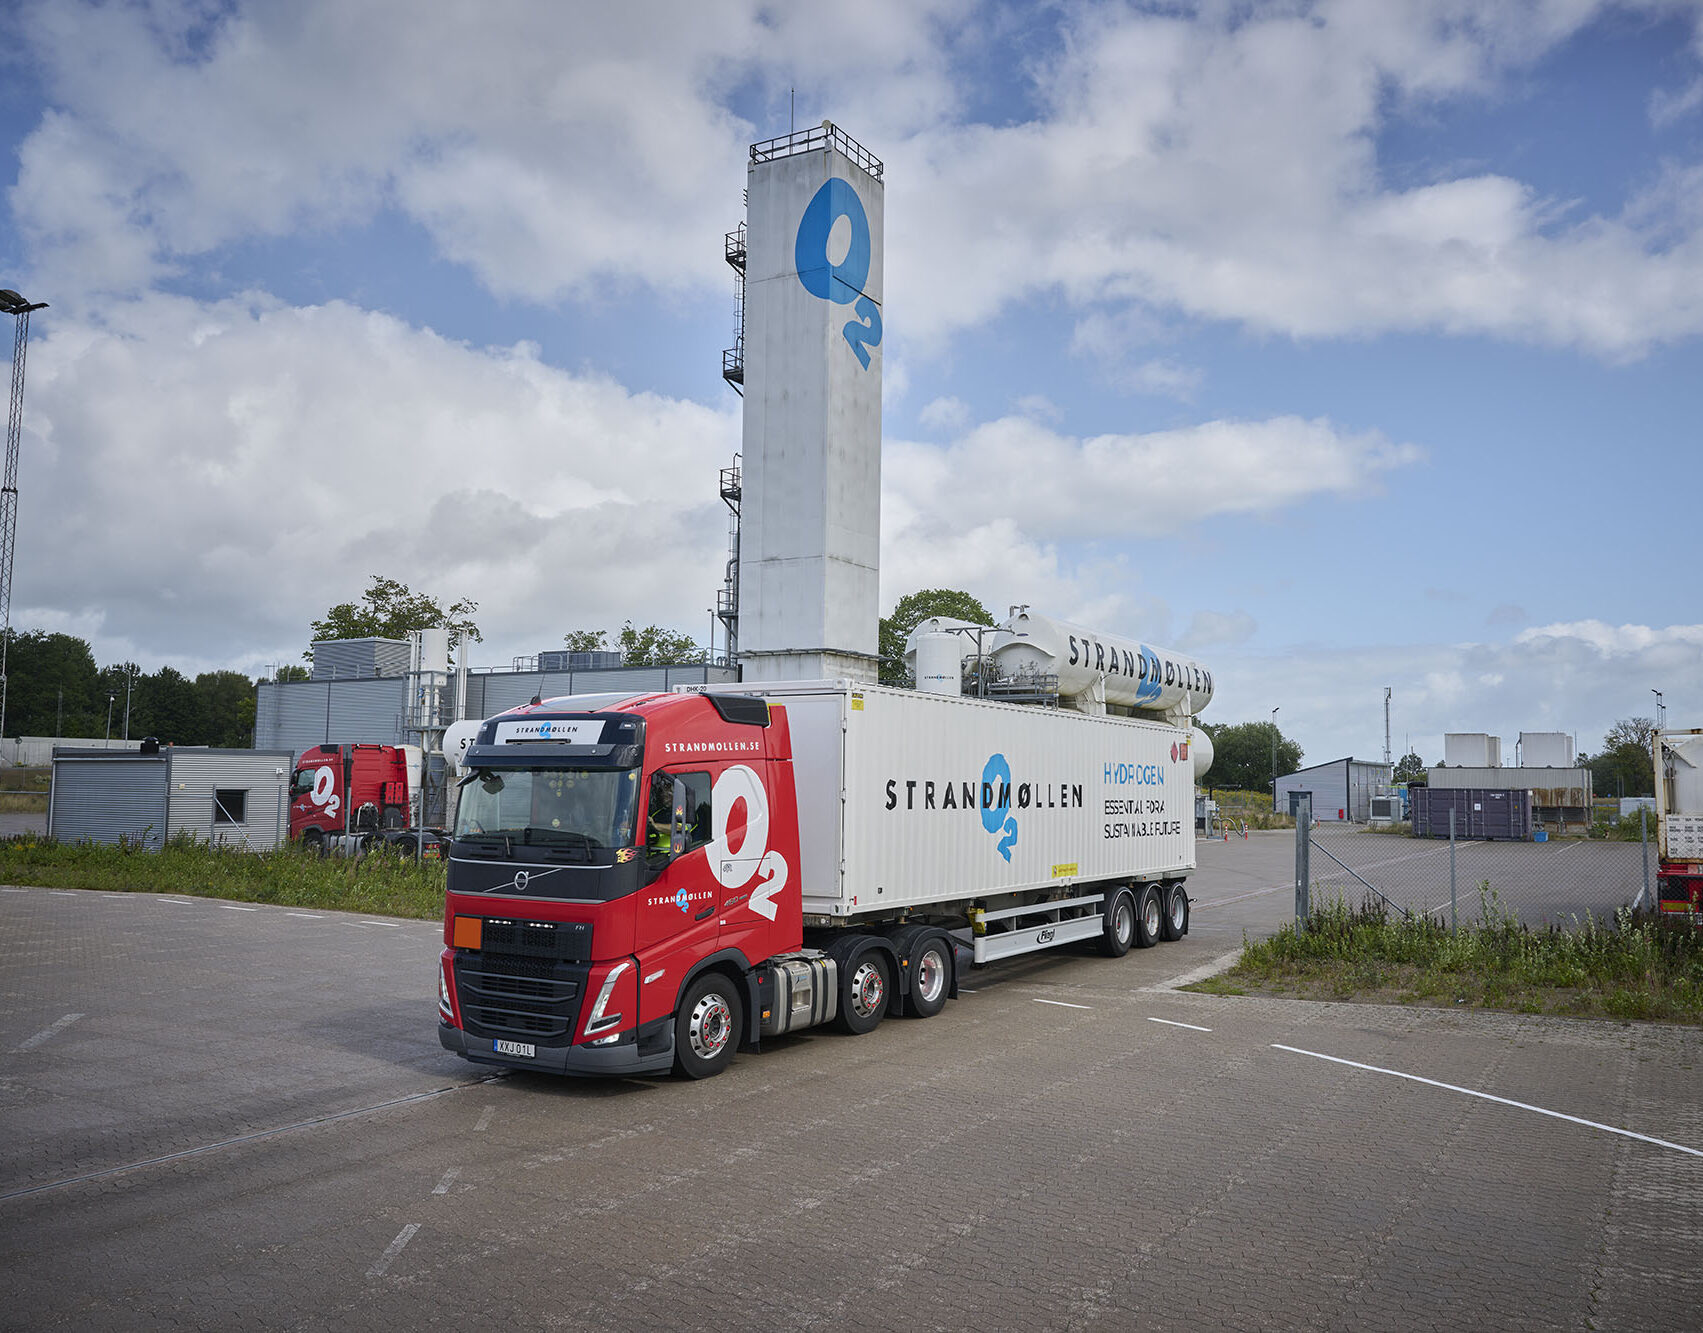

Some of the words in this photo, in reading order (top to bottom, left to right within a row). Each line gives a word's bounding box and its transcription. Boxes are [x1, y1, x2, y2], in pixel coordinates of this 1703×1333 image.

[1069, 634, 1212, 695] STRANDMØLLEN
[665, 741, 760, 752] STRANDMOLLEN.SE
[1104, 762, 1164, 785] HYDROGEN
[885, 779, 1083, 811] STRANDMØLLEN
[1104, 800, 1144, 815] ESSENTAL
[647, 891, 713, 906] STRANDMØLLEN
